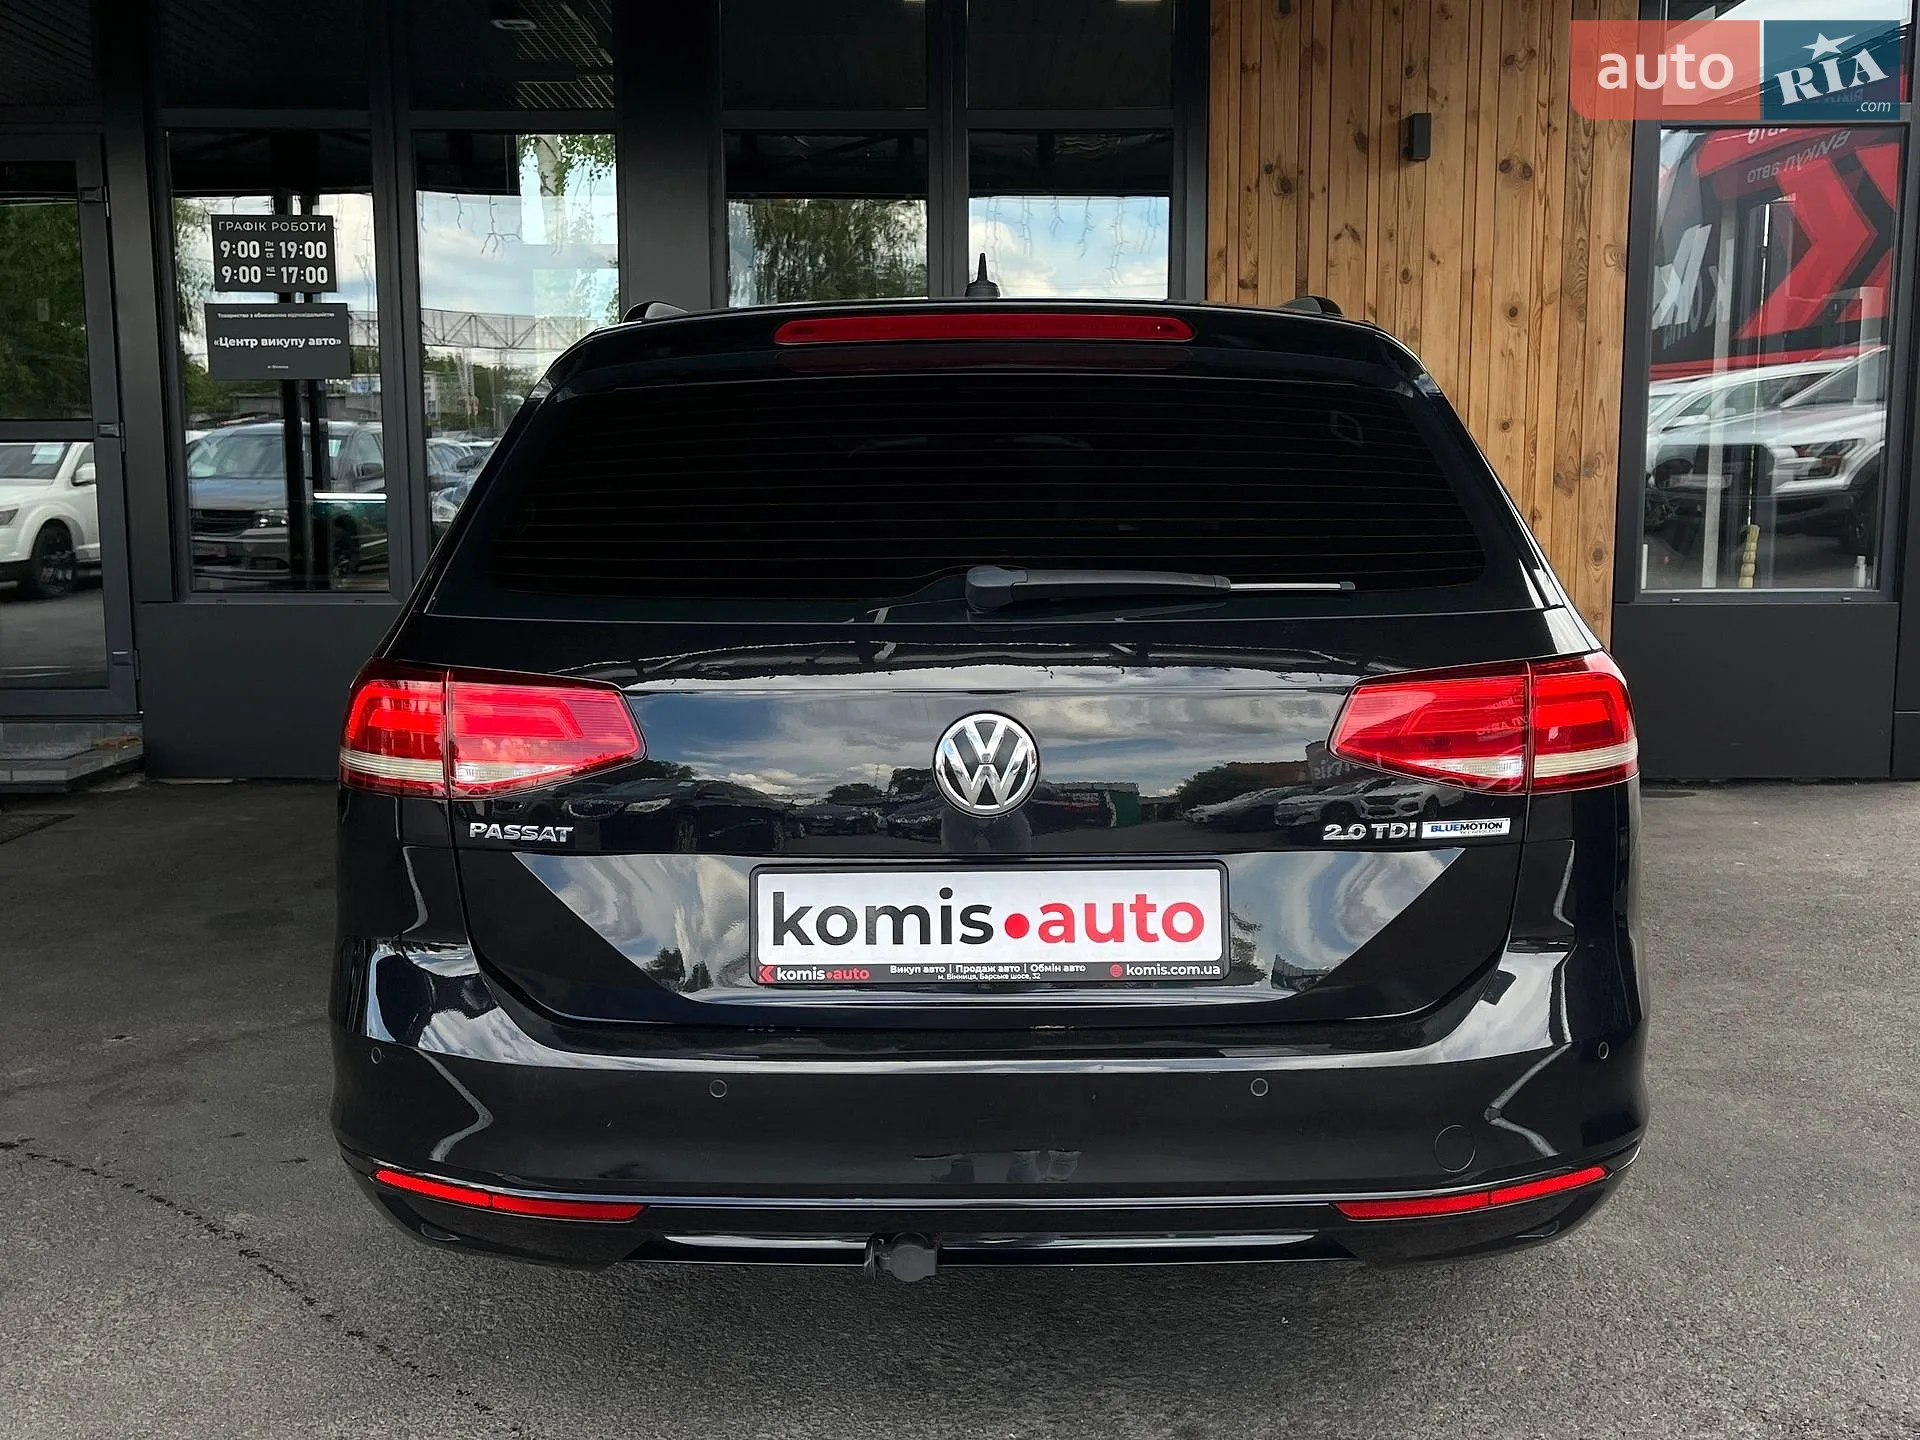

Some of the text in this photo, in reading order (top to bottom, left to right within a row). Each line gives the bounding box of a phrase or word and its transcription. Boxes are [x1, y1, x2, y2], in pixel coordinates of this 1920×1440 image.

[218, 221, 326, 232] ГРАФІК РОБОТИ
[219, 240, 327, 259] 9:00 19:00
[221, 265, 262, 284] 9:00
[281, 266, 328, 284] 17:00
[261, 337, 305, 349] викупу
[469, 822, 573, 844] PASSAT
[1371, 822, 1418, 839] TDI
[889, 965, 922, 975] Викуп
[955, 964, 996, 974] Продаж
[997, 964, 1021, 973] авто
[1030, 963, 1062, 973] Обмін
[1063, 964, 1087, 973] авто
[1126, 963, 1221, 976] komis.com.ua
